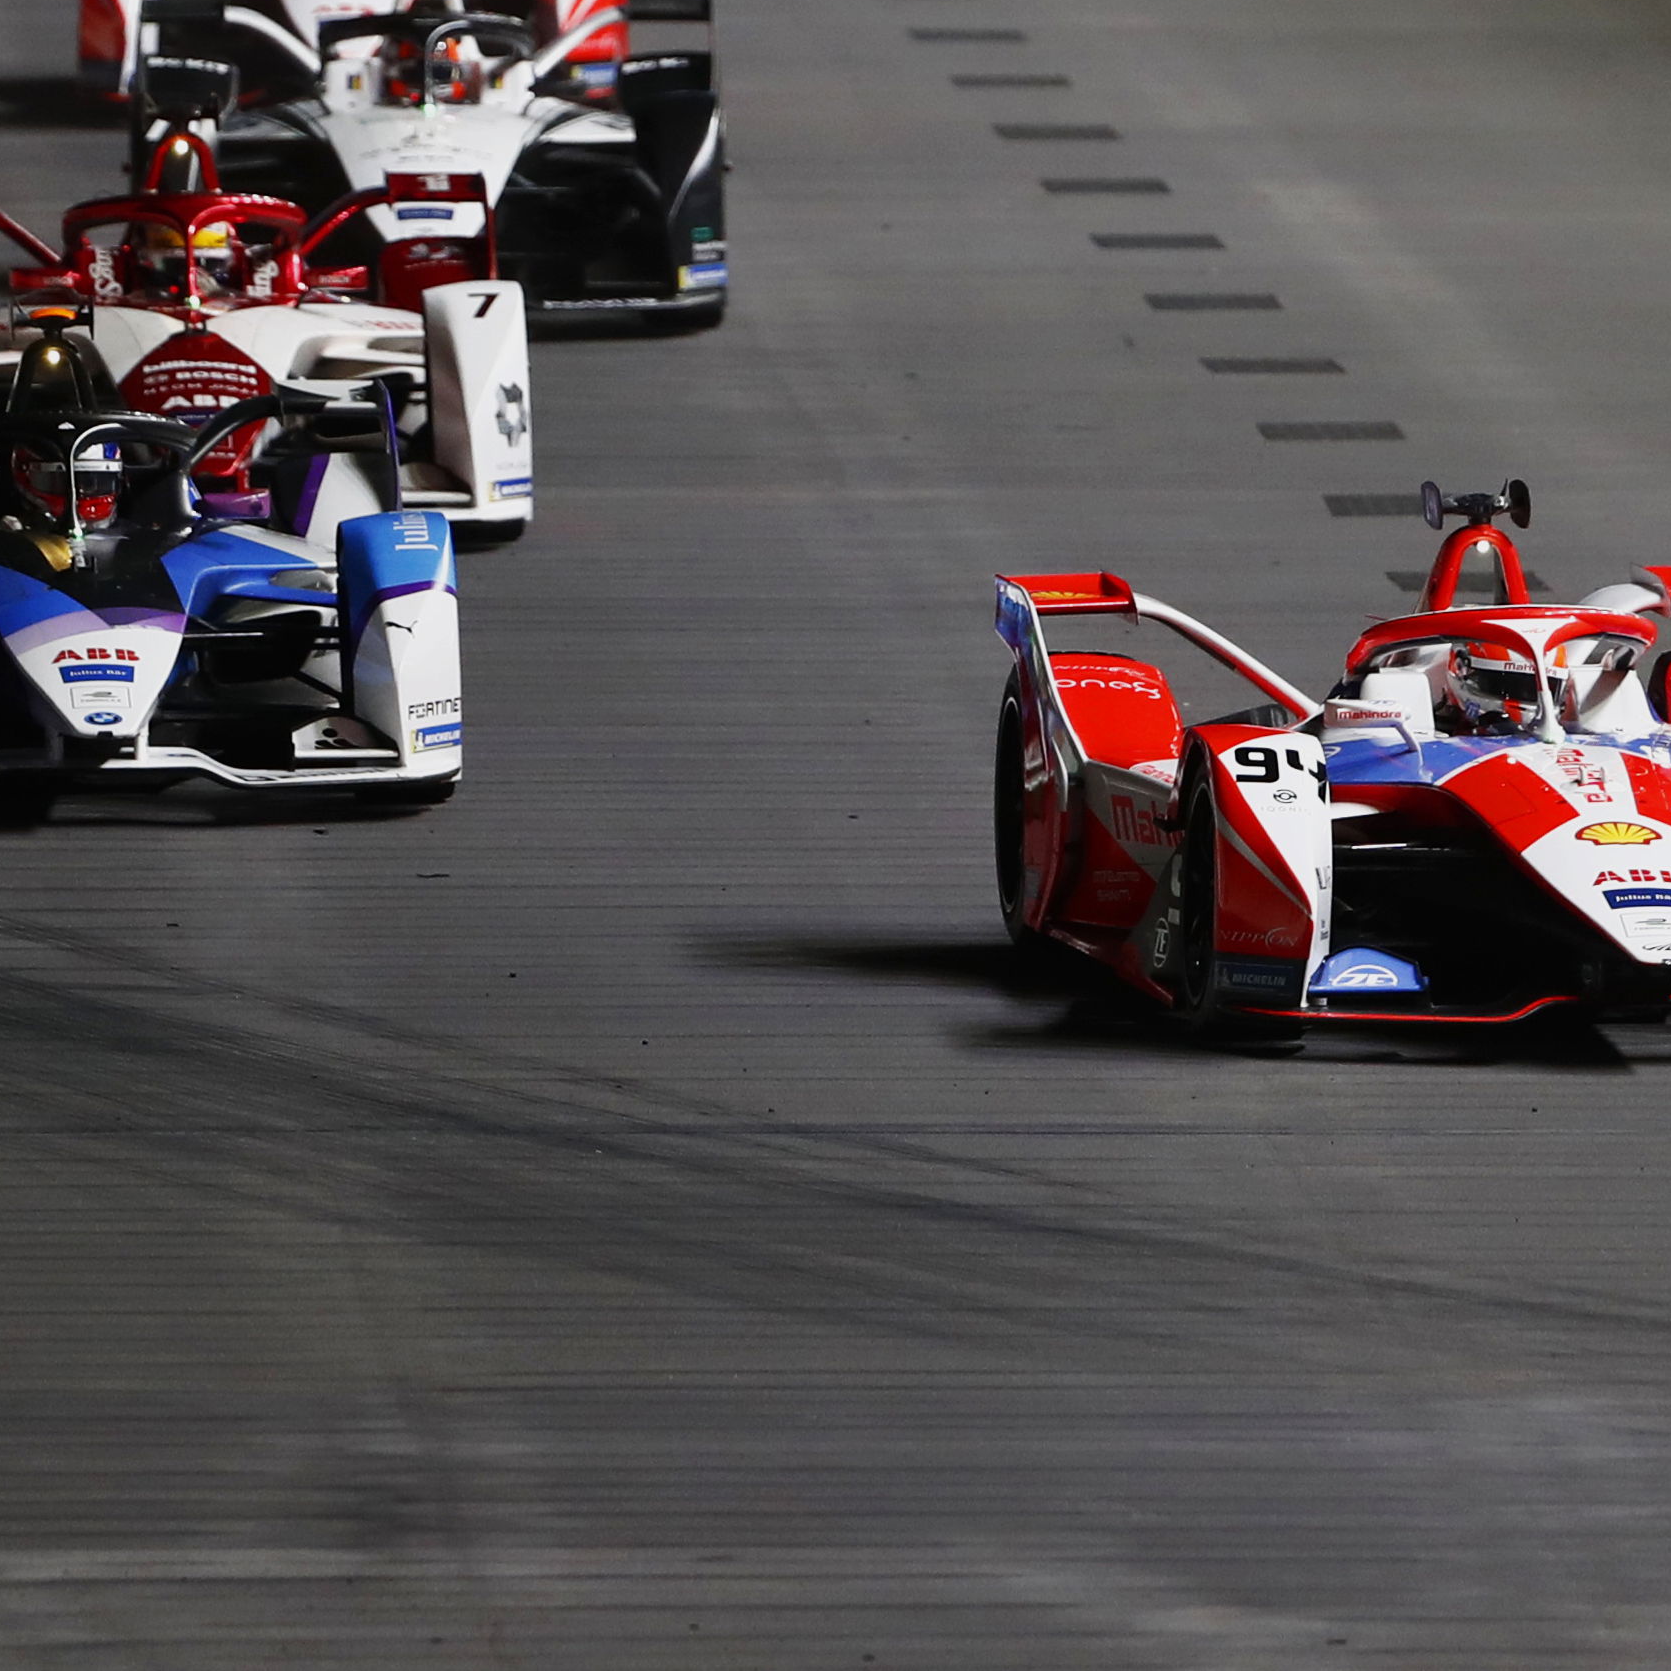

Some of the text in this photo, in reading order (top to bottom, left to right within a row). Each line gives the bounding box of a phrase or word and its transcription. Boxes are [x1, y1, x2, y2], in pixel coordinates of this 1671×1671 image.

[467, 292, 502, 318] 7
[142, 360, 258, 375] billboard
[175, 370, 259, 385] BOSCH
[51, 648, 140, 664] ABB
[408, 697, 463, 723] FORTINE
[1338, 710, 1402, 721] Mahindra
